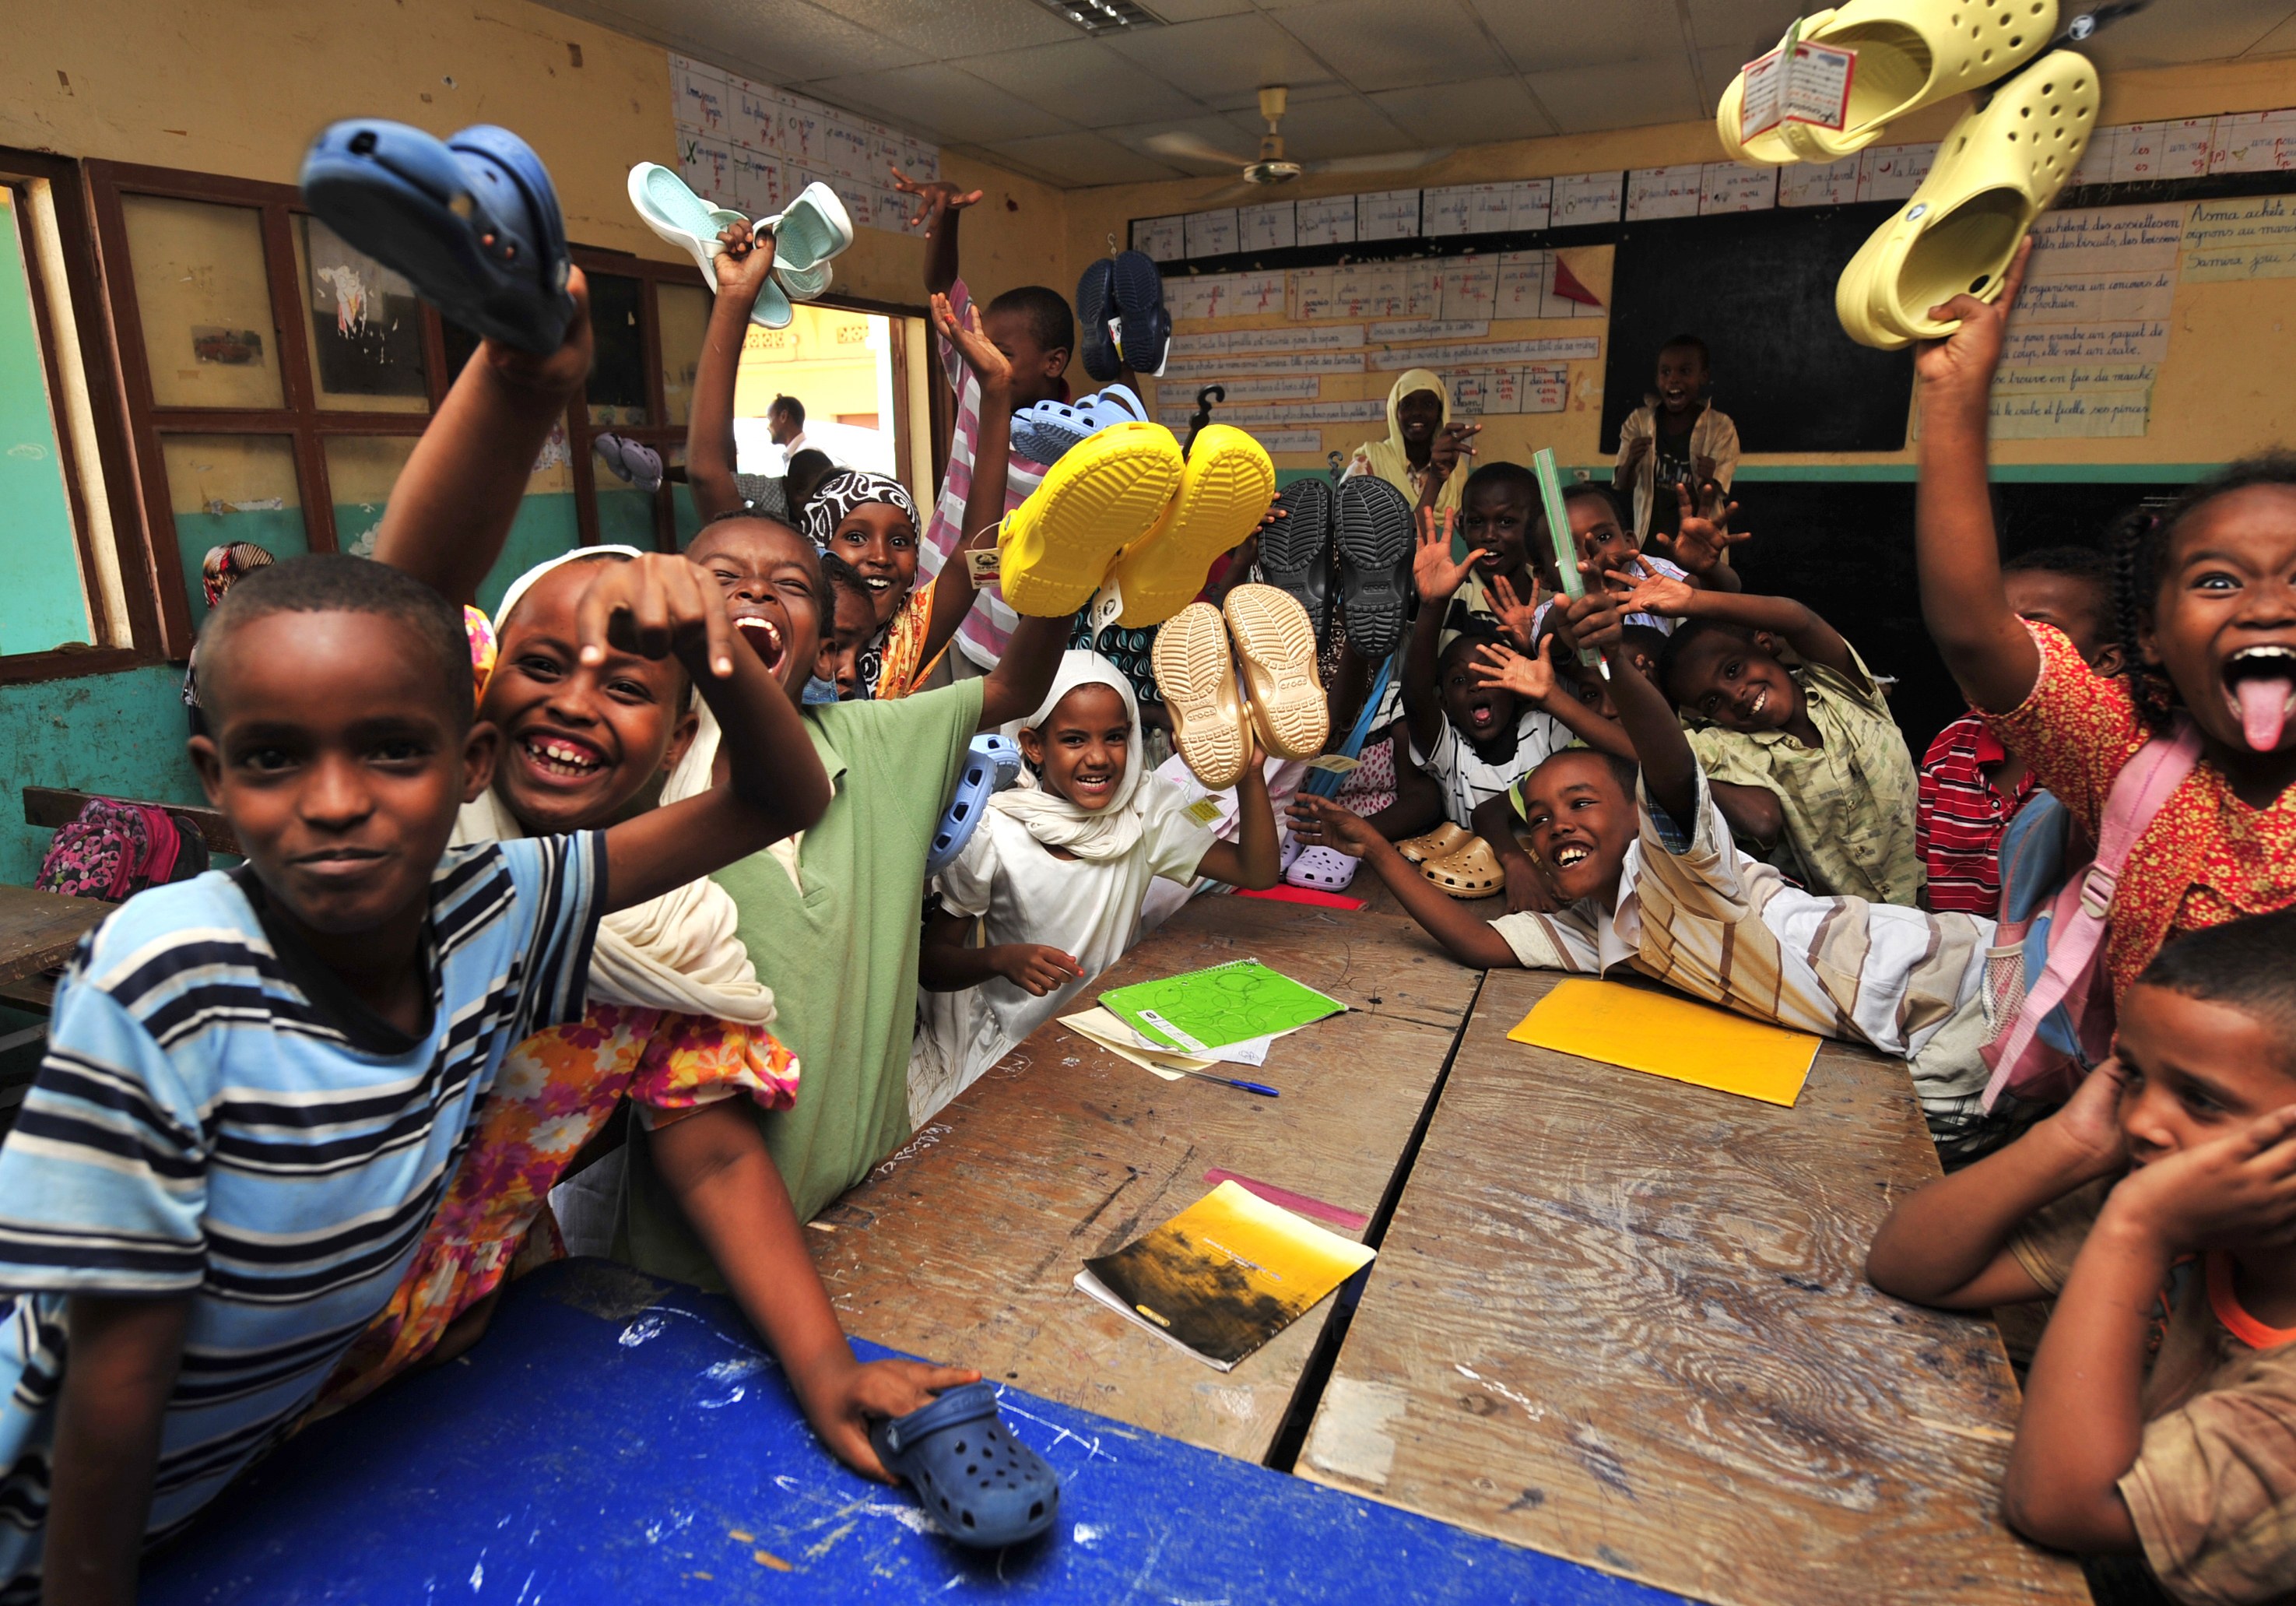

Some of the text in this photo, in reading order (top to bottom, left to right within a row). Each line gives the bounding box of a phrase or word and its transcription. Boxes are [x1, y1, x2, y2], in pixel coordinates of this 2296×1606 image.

[2130, 138, 2150, 156] les
[2170, 142, 2208, 155] un nez
[2252, 139, 2273, 148] une
[1824, 163, 1856, 181] cheval
[1891, 160, 1929, 178] la lun
[2135, 163, 2148, 171] es
[2191, 203, 2239, 223] Asma
[2093, 216, 2112, 230] des
[2114, 214, 2167, 230] assiettes
[2059, 234, 2075, 248] des
[2119, 233, 2138, 246] des
[2185, 227, 2234, 248] oignons
[2238, 227, 2255, 236] au
[2187, 252, 2280, 274] Samira joue
[2030, 283, 2085, 300] organisera
[2109, 281, 2151, 291] concours
[2155, 276, 2168, 287] de
[2024, 333, 2044, 348] pour
[2049, 327, 2085, 346] prendre
[2109, 323, 2145, 344] paquet
[2149, 324, 2163, 336] de
[1525, 343, 1535, 352] du
[1554, 339, 1563, 350] de
[2041, 343, 2059, 357] elle
[2063, 343, 2081, 356] voit
[2087, 346, 2104, 354] un
[2107, 340, 2140, 355] crabe.
[1196, 360, 1214, 377] photo
[1322, 354, 1332, 364] des
[1249, 378, 1273, 392] cahiers
[1496, 374, 1516, 386] cent
[2010, 371, 2047, 384] trouve
[2070, 368, 2090, 391] face
[2094, 367, 2109, 381] du
[1453, 395, 1480, 407] cham
[2005, 402, 2017, 415] le
[2015, 400, 2040, 416] crabe
[2045, 402, 2053, 415] et
[2055, 400, 2084, 423] ficelle
[2090, 406, 2110, 414] ses
[1280, 679, 1307, 690] crocs
[1187, 709, 1216, 722] crocs
